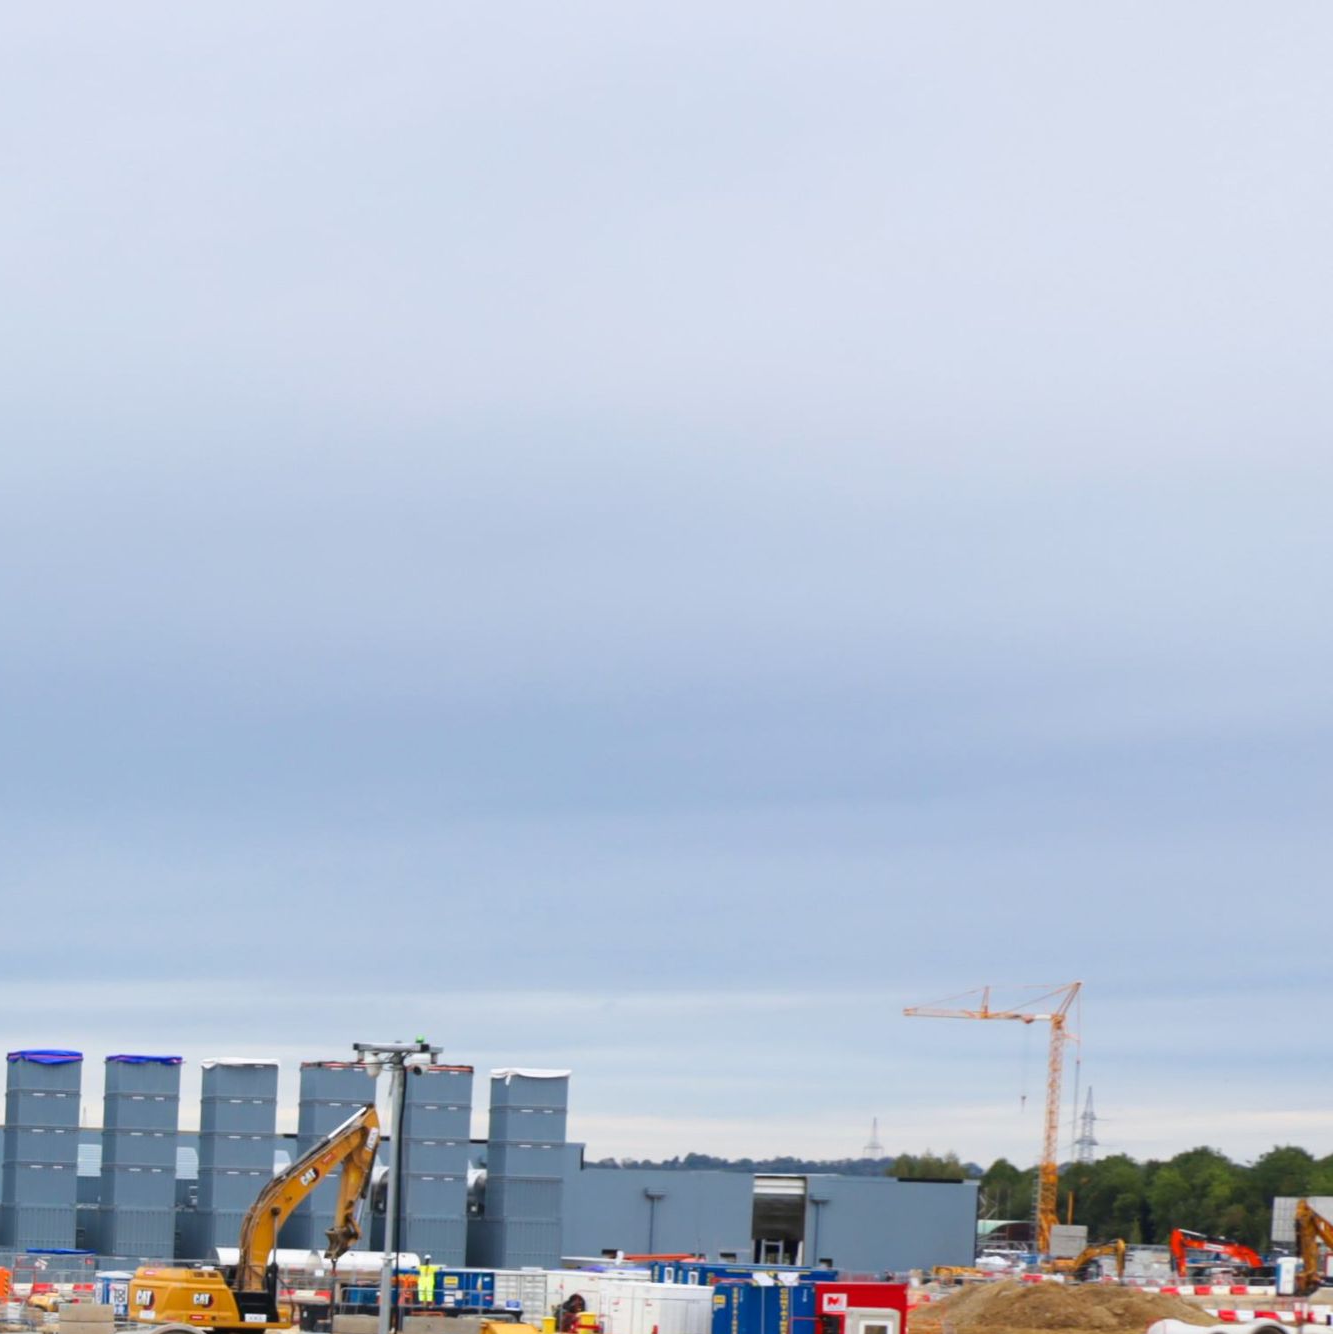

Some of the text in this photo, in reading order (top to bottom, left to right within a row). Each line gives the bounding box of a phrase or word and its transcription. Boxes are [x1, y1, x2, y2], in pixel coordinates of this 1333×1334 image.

[300, 1168, 316, 1186] CAT
[136, 1289, 152, 1306] CAT
[193, 1293, 210, 1306] CAT
